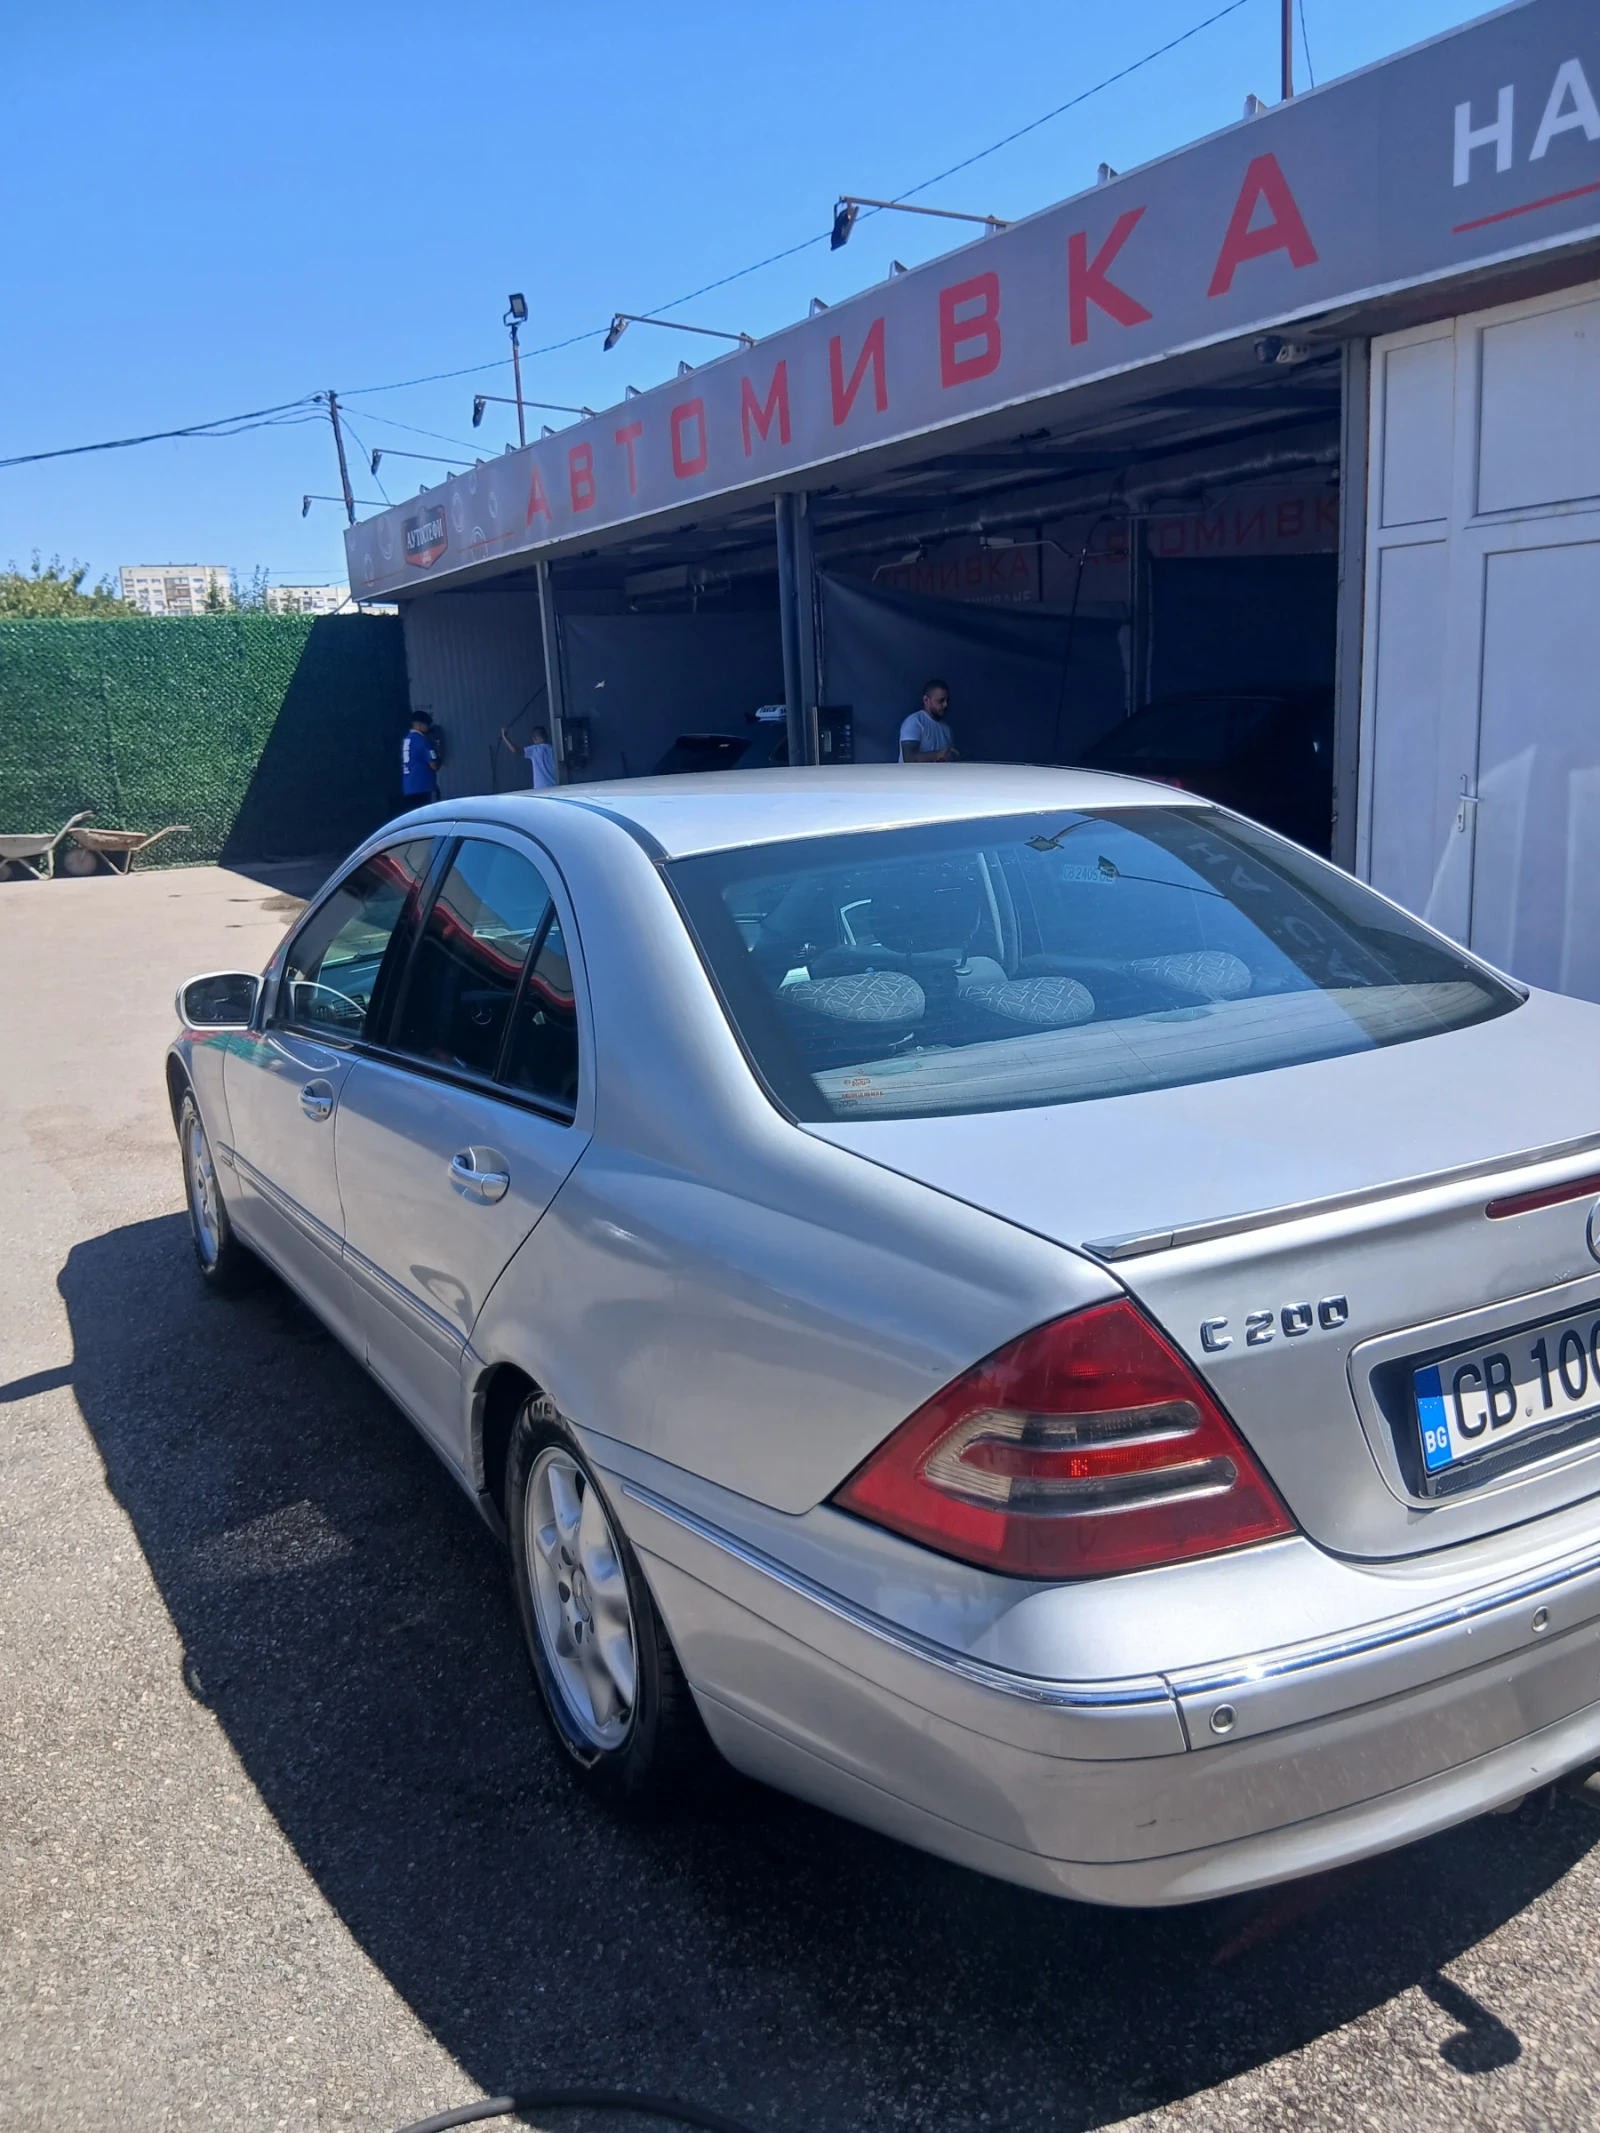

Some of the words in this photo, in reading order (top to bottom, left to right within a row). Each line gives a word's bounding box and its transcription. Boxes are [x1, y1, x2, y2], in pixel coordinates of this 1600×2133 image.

[526, 151, 1319, 527] АВТОМИВКА
[1453, 57, 1600, 187] НА
[1200, 1316, 1234, 1353] C
[1245, 1294, 1349, 1347] 200
[1424, 1426, 1448, 1454] BG
